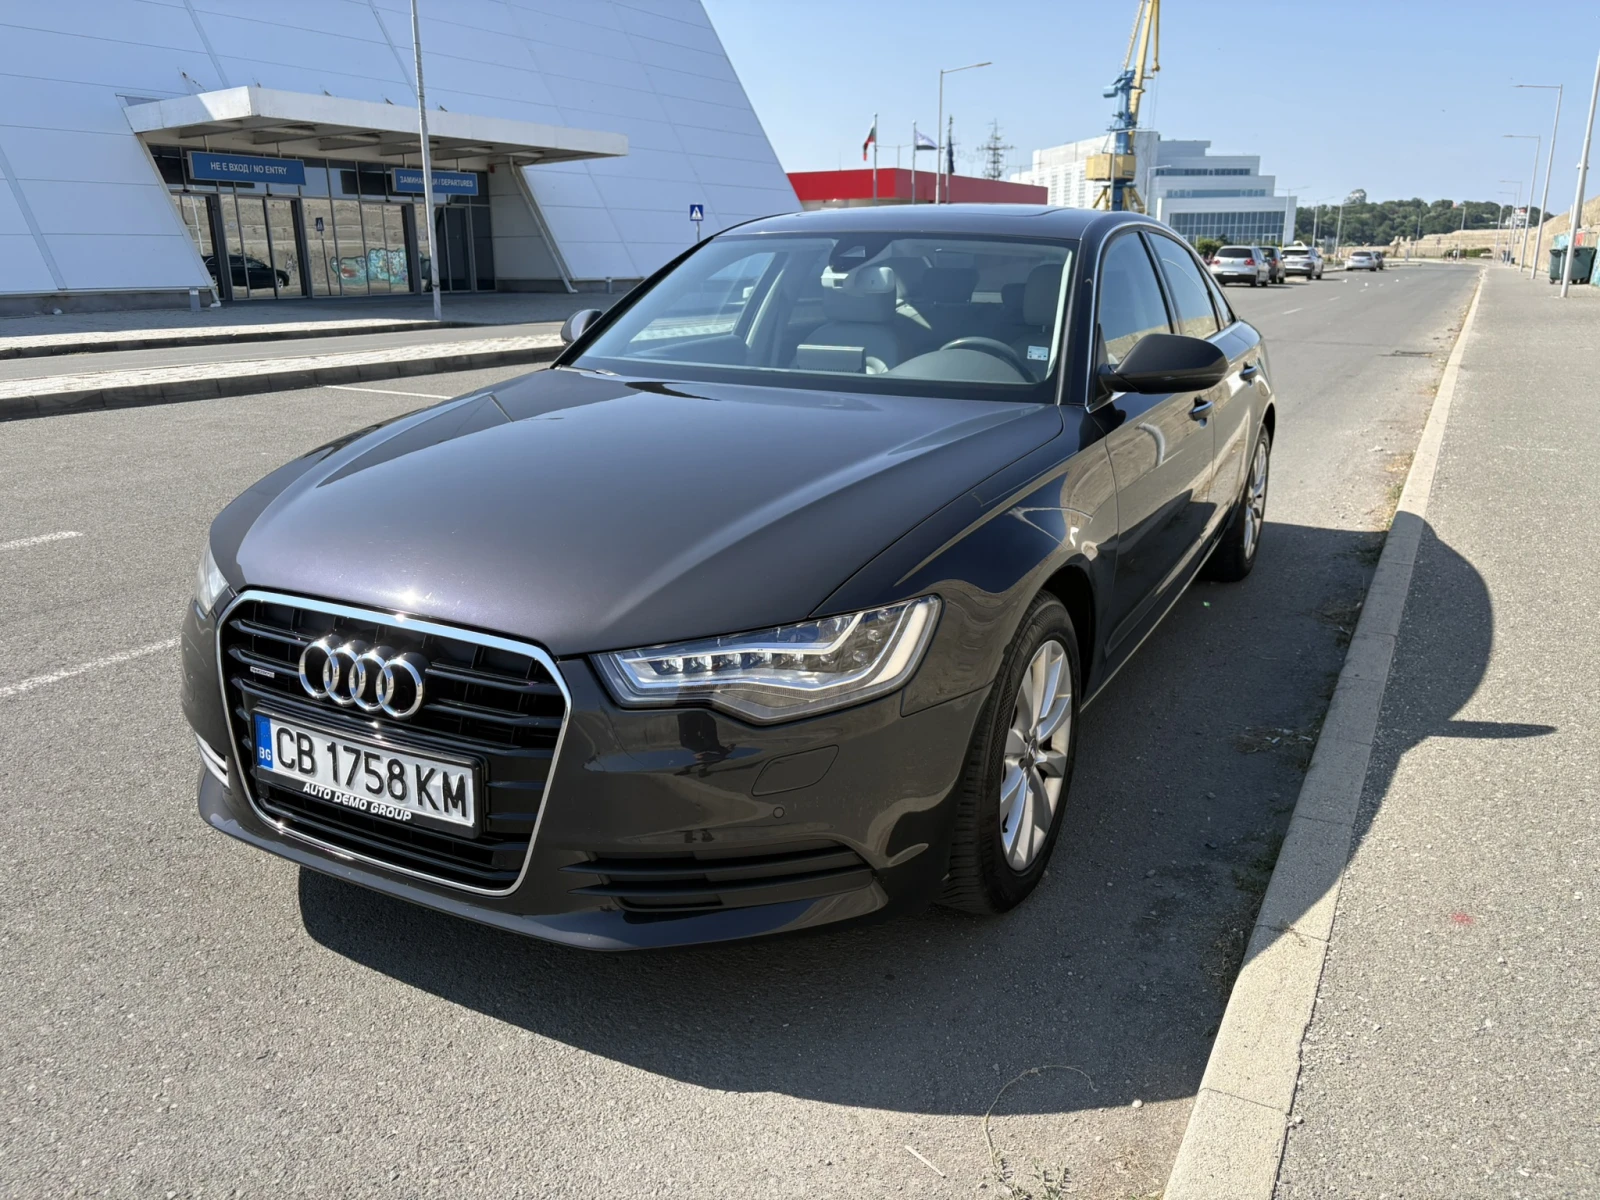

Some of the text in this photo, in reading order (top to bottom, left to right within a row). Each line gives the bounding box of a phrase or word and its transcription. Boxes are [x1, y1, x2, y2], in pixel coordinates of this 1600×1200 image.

[210, 161, 221, 171] НЕ
[222, 162, 228, 171] Е
[229, 163, 250, 174] ВХОД
[253, 165, 265, 174] NO
[265, 166, 287, 175] ENTRY
[399, 175, 438, 186] ЗАМИНАИ
[441, 178, 474, 188] DEPARTURES
[258, 746, 272, 761] BG
[276, 726, 467, 818] CB 1758 KM
[302, 782, 412, 822] AUTO DEMO GROUP
